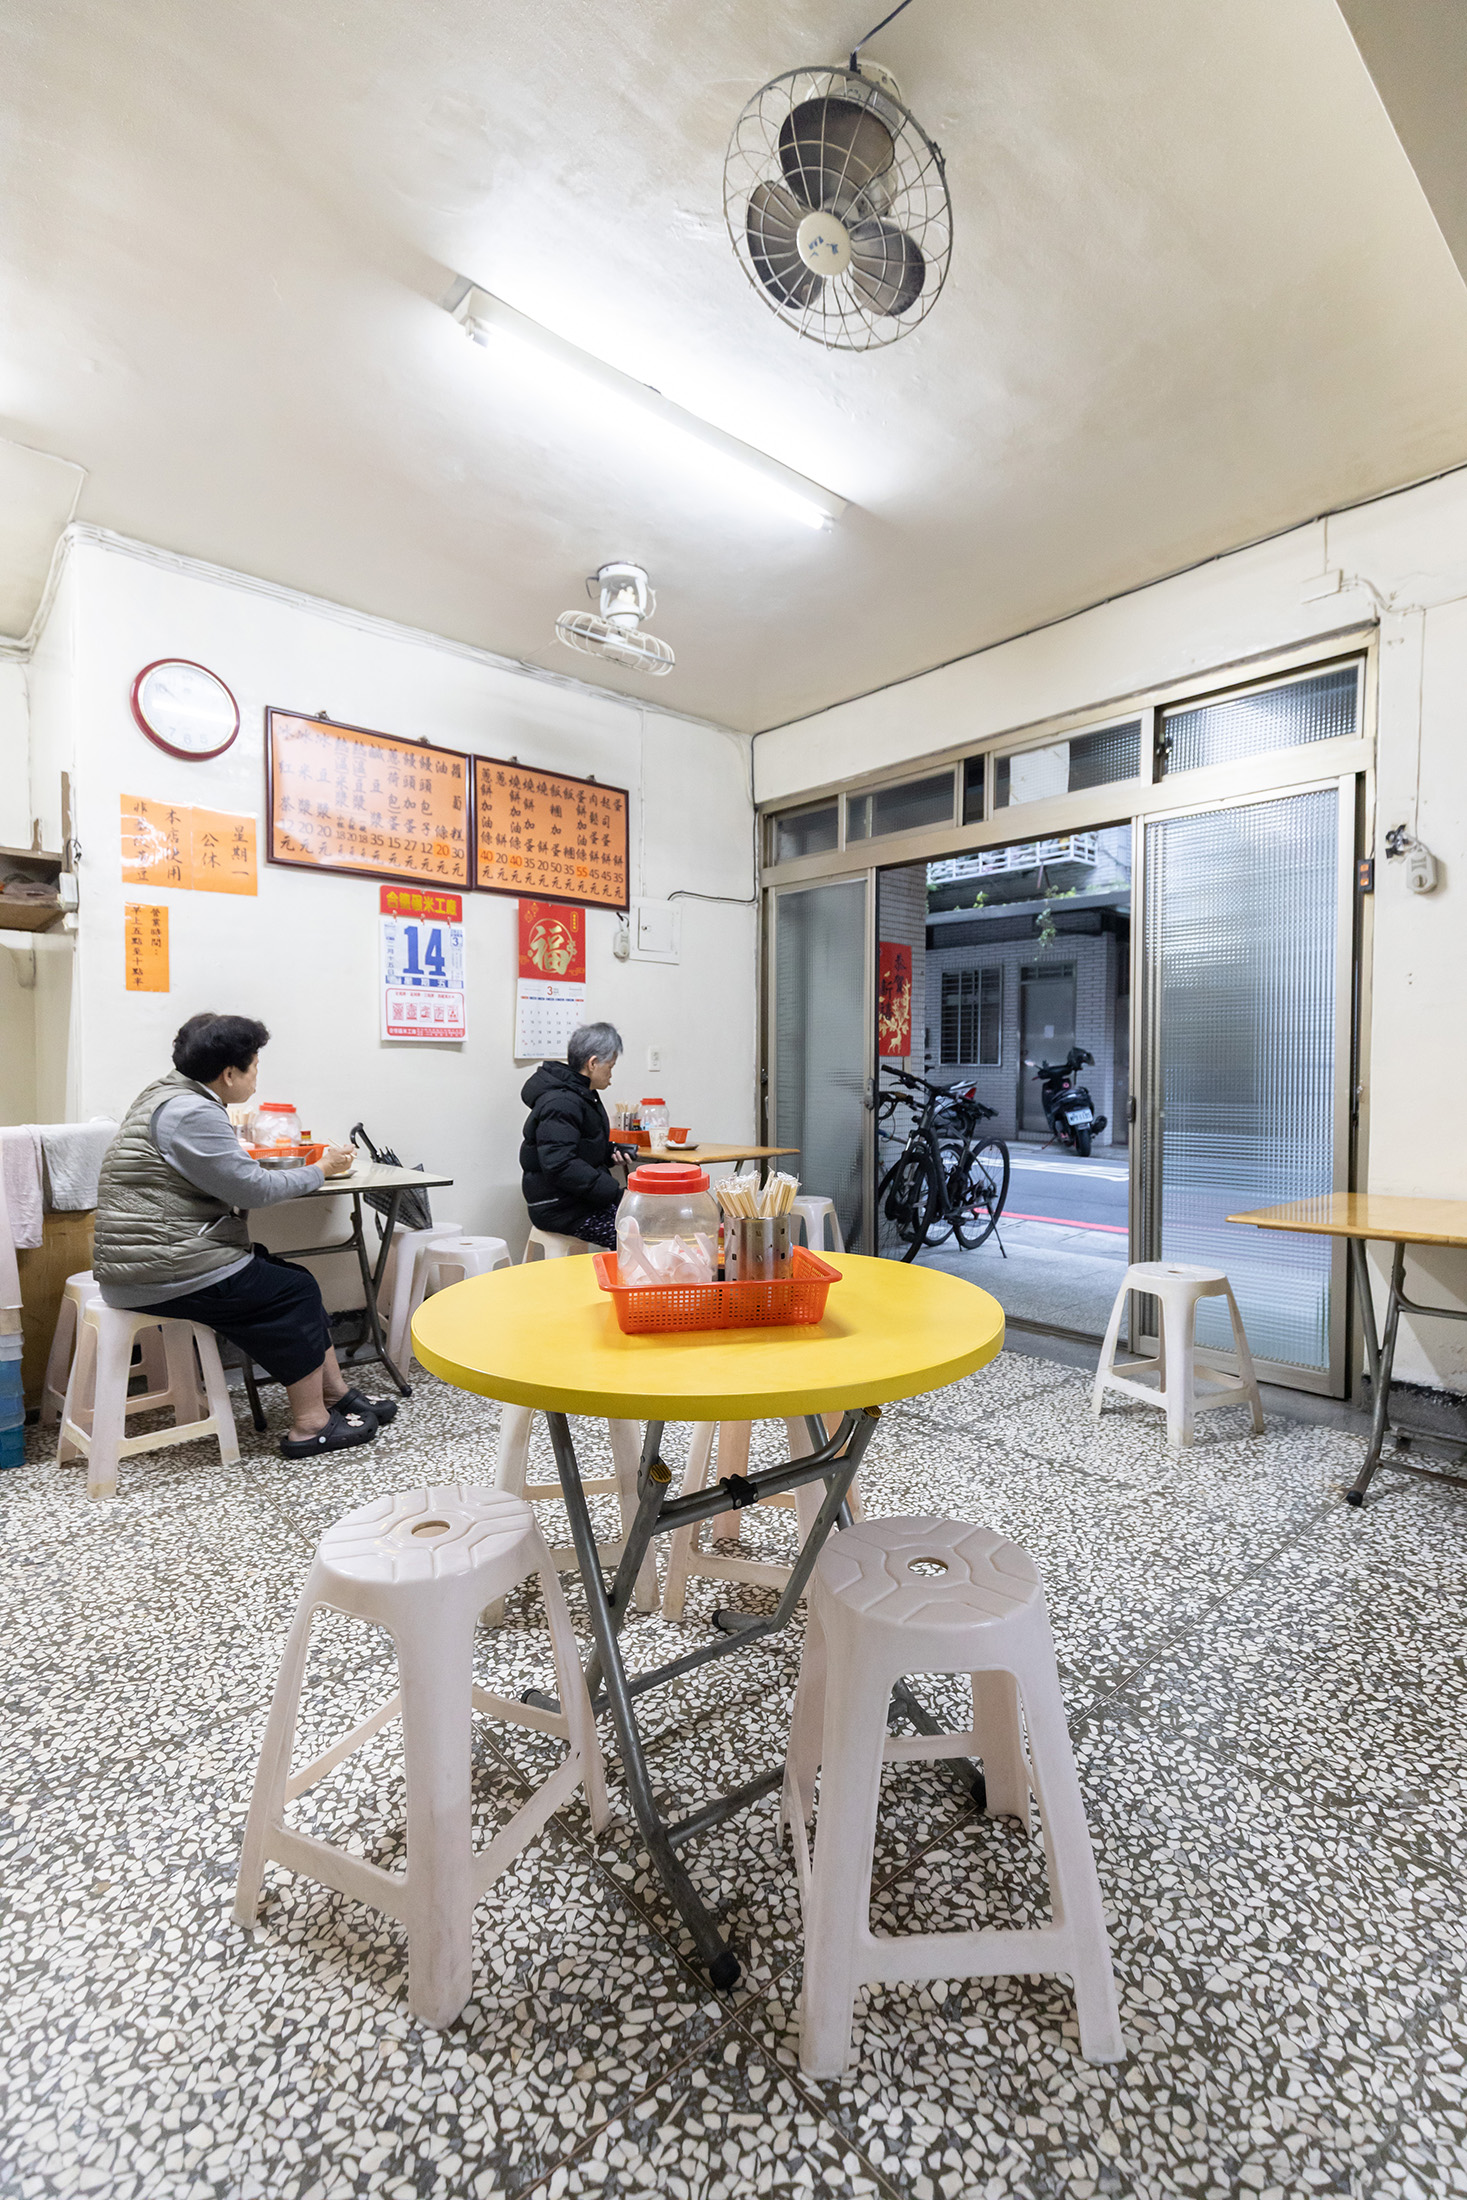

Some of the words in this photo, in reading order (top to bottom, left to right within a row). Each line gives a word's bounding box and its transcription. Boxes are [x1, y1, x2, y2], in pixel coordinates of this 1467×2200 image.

[200, 832, 222, 869] 公休
[230, 824, 250, 878] 星期一
[402, 925, 447, 977] 14
[530, 924, 570, 976] 福
[547, 985, 553, 996] 3
